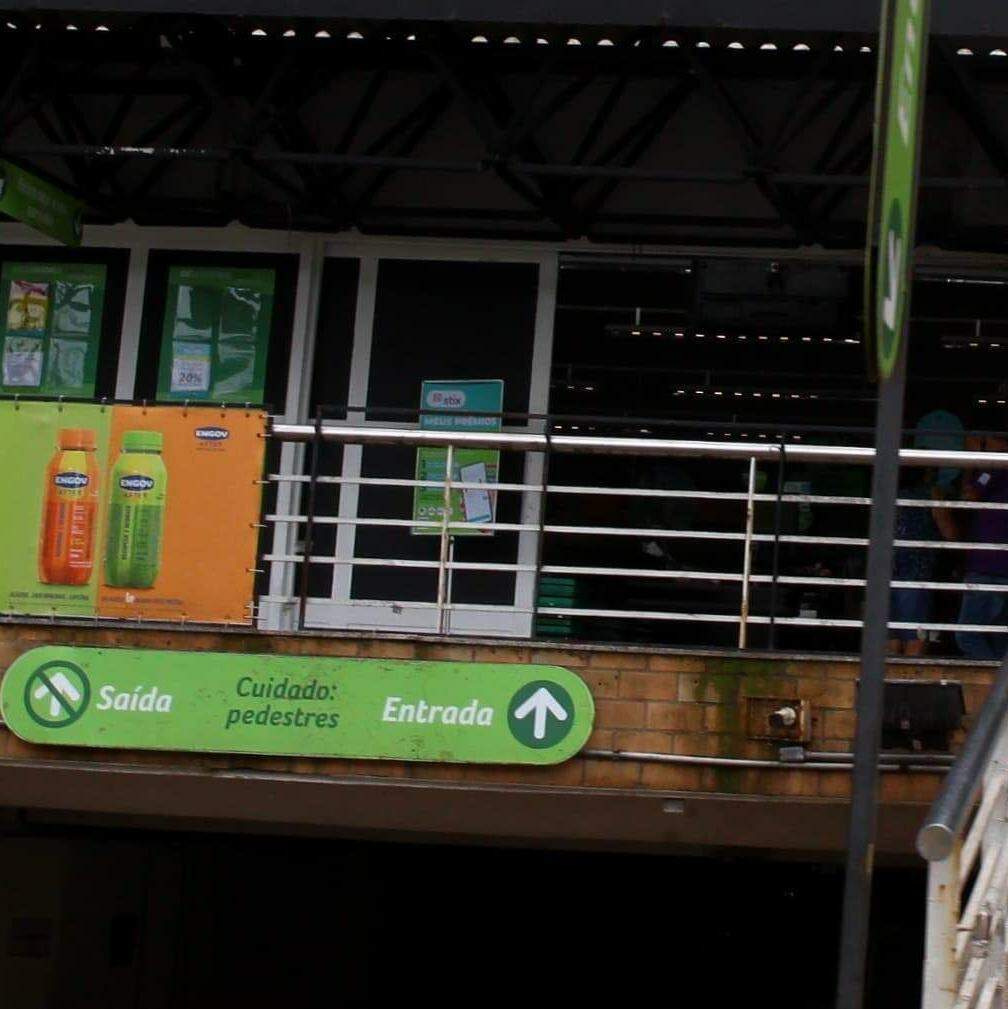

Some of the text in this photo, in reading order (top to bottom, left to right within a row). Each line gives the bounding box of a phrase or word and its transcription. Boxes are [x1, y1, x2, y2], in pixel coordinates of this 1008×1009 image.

[54, 475, 88, 486] ENGOV
[119, 478, 154, 488] ENGOV
[96, 684, 173, 713] Saída
[236, 676, 338, 701] Cuidado:
[225, 703, 340, 730] pedestres
[382, 696, 494, 727] Entrada
